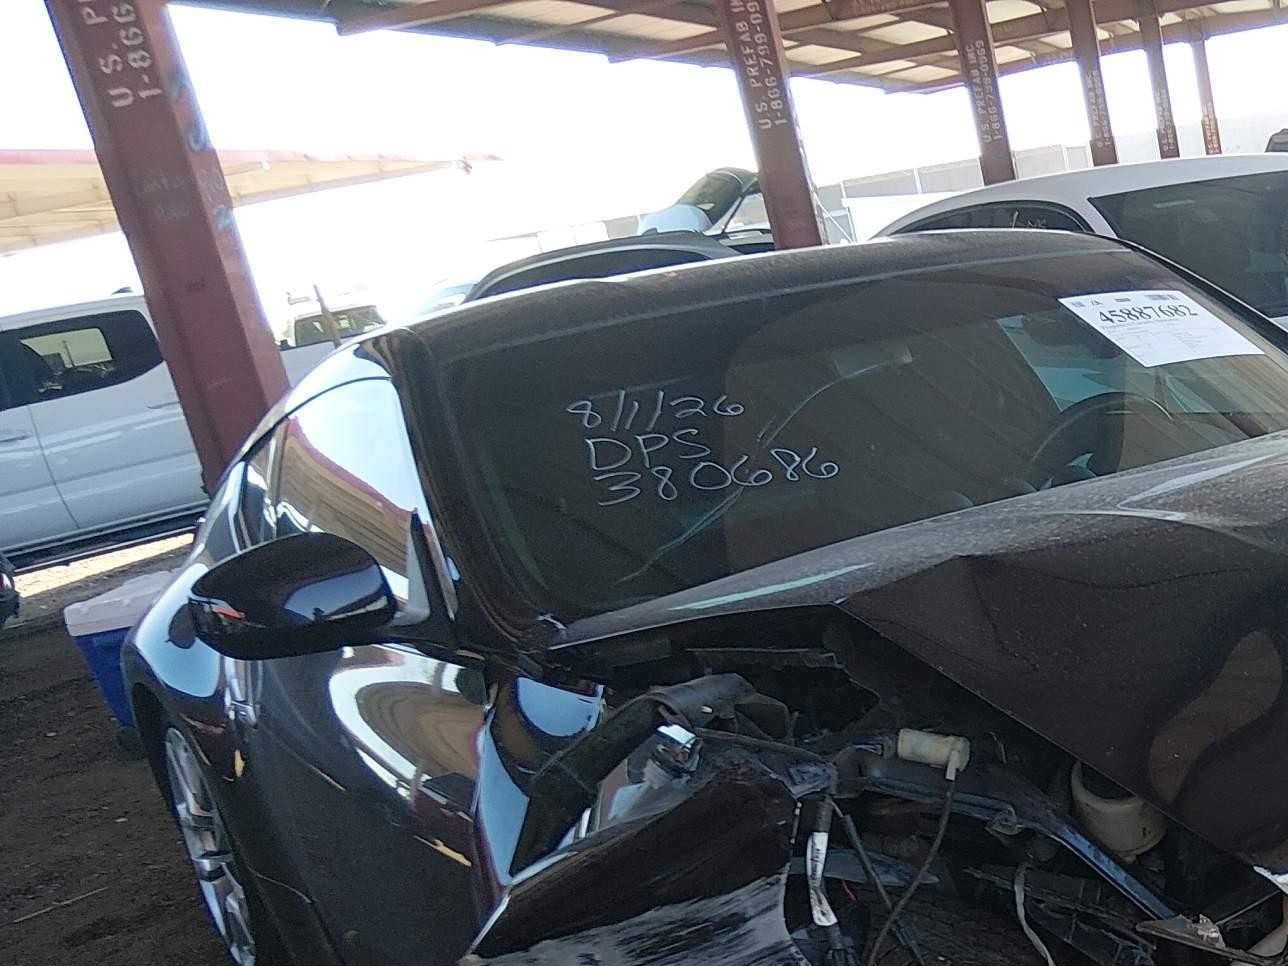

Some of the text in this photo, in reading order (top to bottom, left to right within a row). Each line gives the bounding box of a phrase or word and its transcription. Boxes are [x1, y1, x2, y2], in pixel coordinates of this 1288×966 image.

[735, 21, 763, 88] PREFAB
[1100, 304, 1199, 324] 45887682
[566, 390, 745, 431] 8/1/26
[585, 429, 712, 471] DPS
[593, 447, 840, 506] 380686
